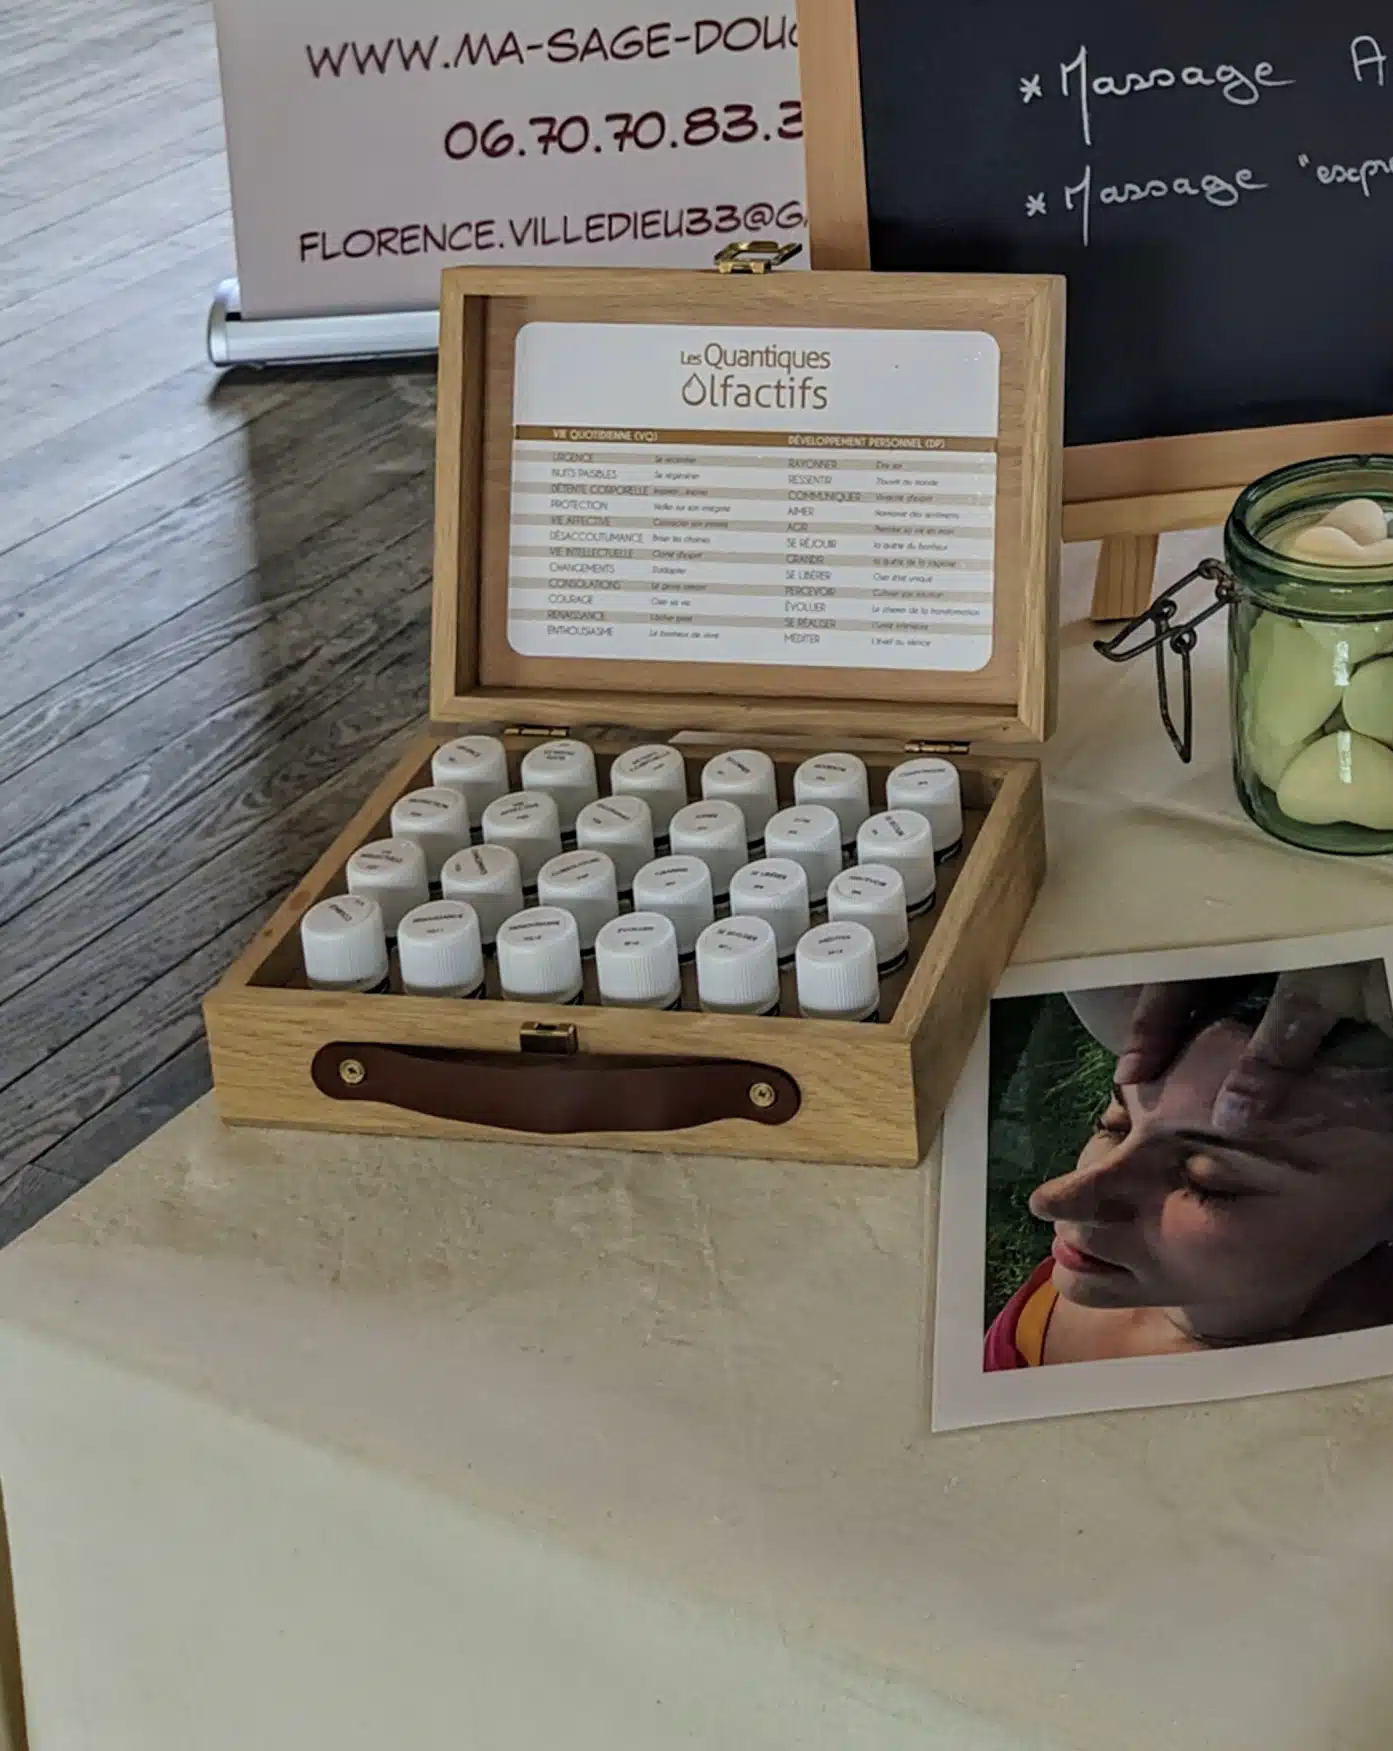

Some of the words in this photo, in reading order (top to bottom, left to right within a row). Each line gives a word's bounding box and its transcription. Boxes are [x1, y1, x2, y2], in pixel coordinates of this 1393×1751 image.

[304, 14, 798, 79] WWW.MA-SAGE-DOU
[443, 100, 804, 160] 06.70.70.83.3
[299, 200, 807, 263] FLORENCE.VILLEDIEU33@G
[680, 351, 702, 365] Les
[704, 343, 831, 374] Quantiques
